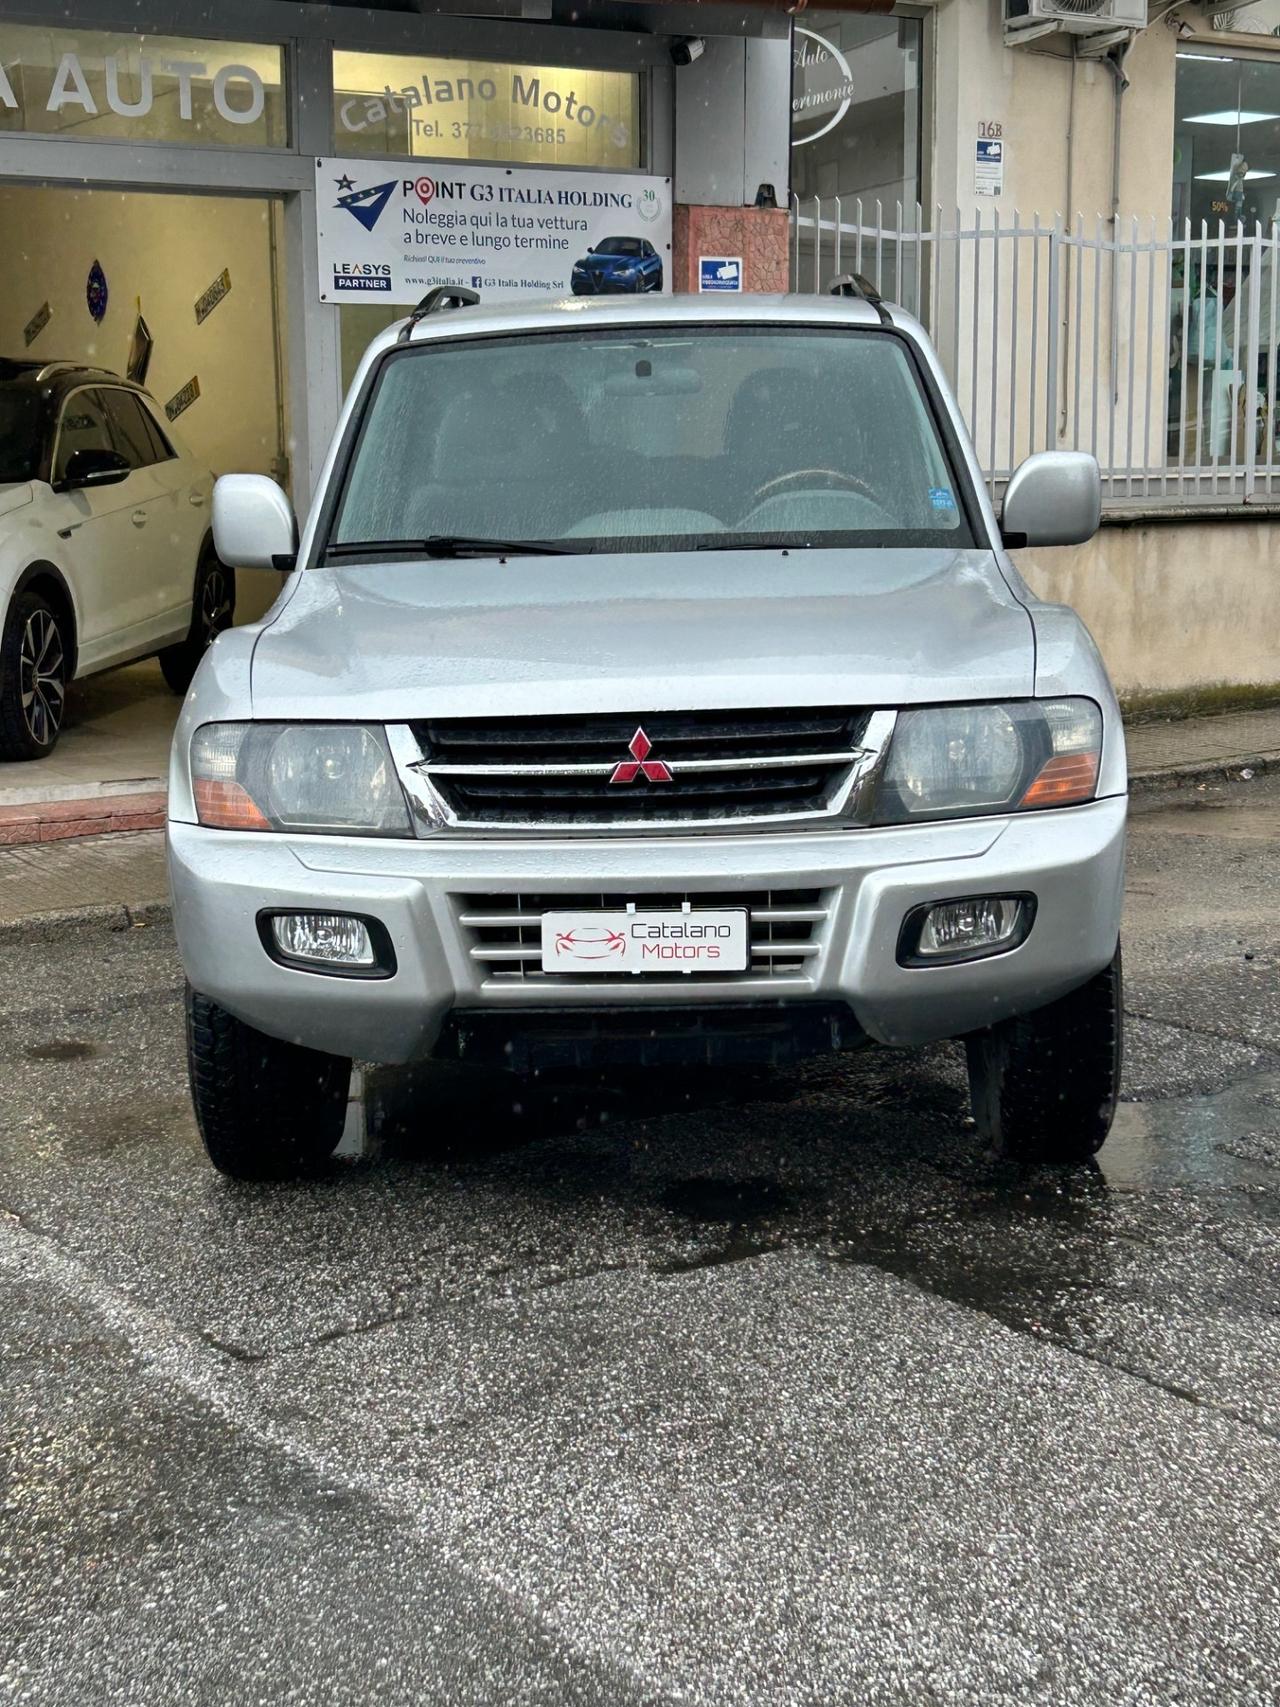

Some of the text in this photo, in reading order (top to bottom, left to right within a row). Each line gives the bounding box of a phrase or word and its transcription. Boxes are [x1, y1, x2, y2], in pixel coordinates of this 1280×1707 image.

[46, 53, 265, 124] AUTO
[792, 78, 854, 111] erimonie
[340, 75, 630, 148] Catalano Motors
[413, 119, 443, 138] Tel.
[980, 121, 1002, 137] 16B
[403, 178, 466, 202] POINT
[470, 184, 494, 201] G3
[499, 187, 554, 204] ITALIA
[558, 190, 632, 208] HOLDING
[403, 208, 588, 231] Noleggia qui la tua vettura
[404, 228, 569, 250] a breve e lungo termine
[333, 263, 391, 275] LEASYS
[338, 278, 387, 289] PARTNER
[631, 922, 731, 939] Catalano
[642, 943, 720, 959] Motors
